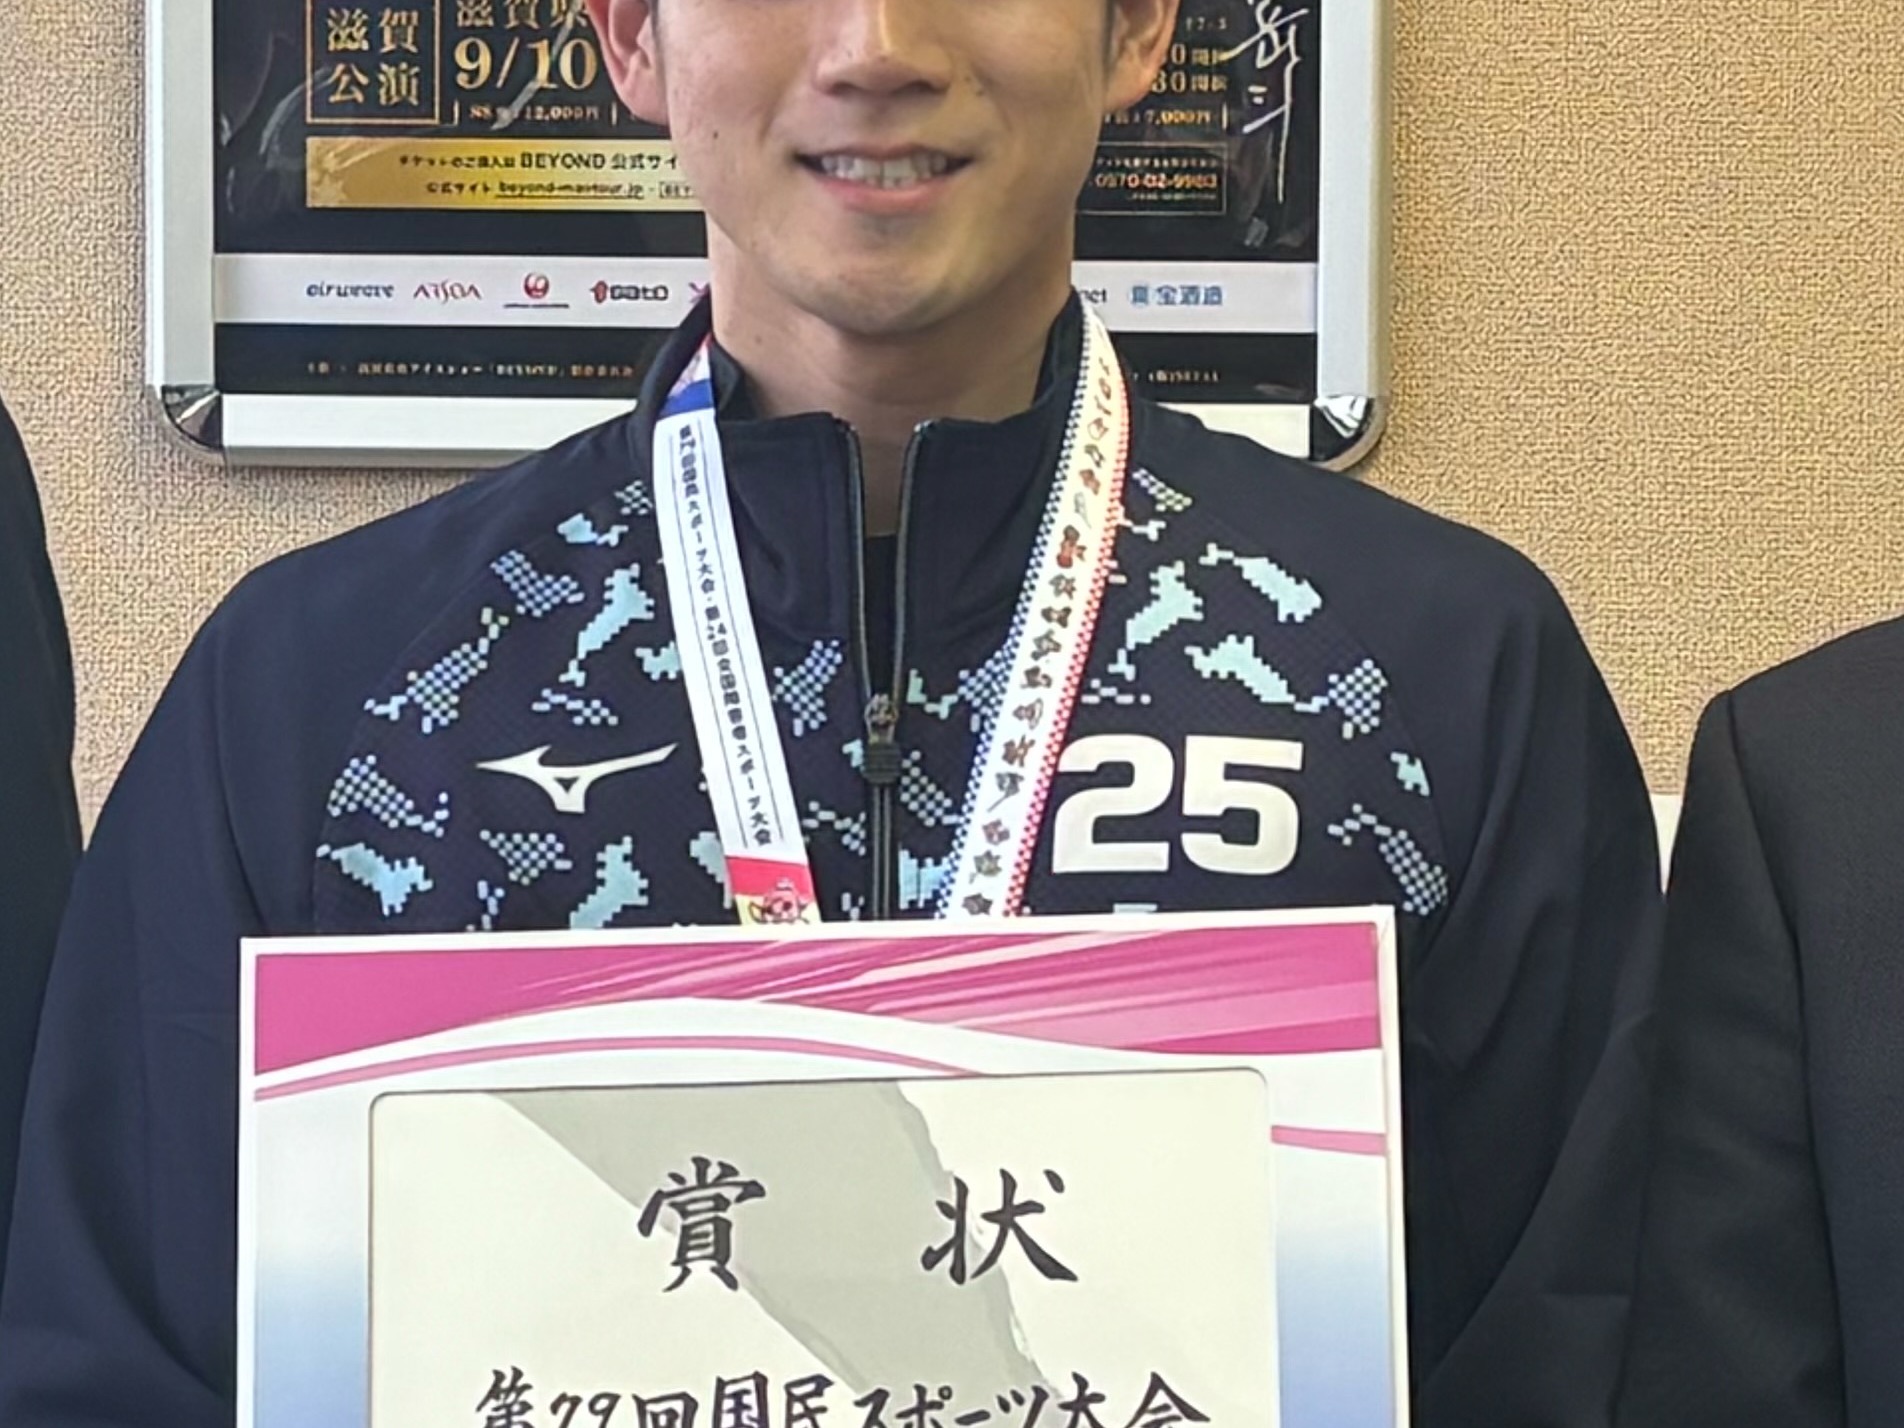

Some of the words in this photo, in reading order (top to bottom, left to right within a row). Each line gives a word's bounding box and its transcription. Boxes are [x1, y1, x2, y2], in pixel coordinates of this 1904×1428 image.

[327, 7, 420, 54] 滋賀
[328, 61, 421, 108] 公演
[453, 37, 597, 90] 9/10
[1052, 733, 1304, 876] 25
[634, 1155, 768, 1295] 賞
[918, 1164, 1081, 1288] 状
